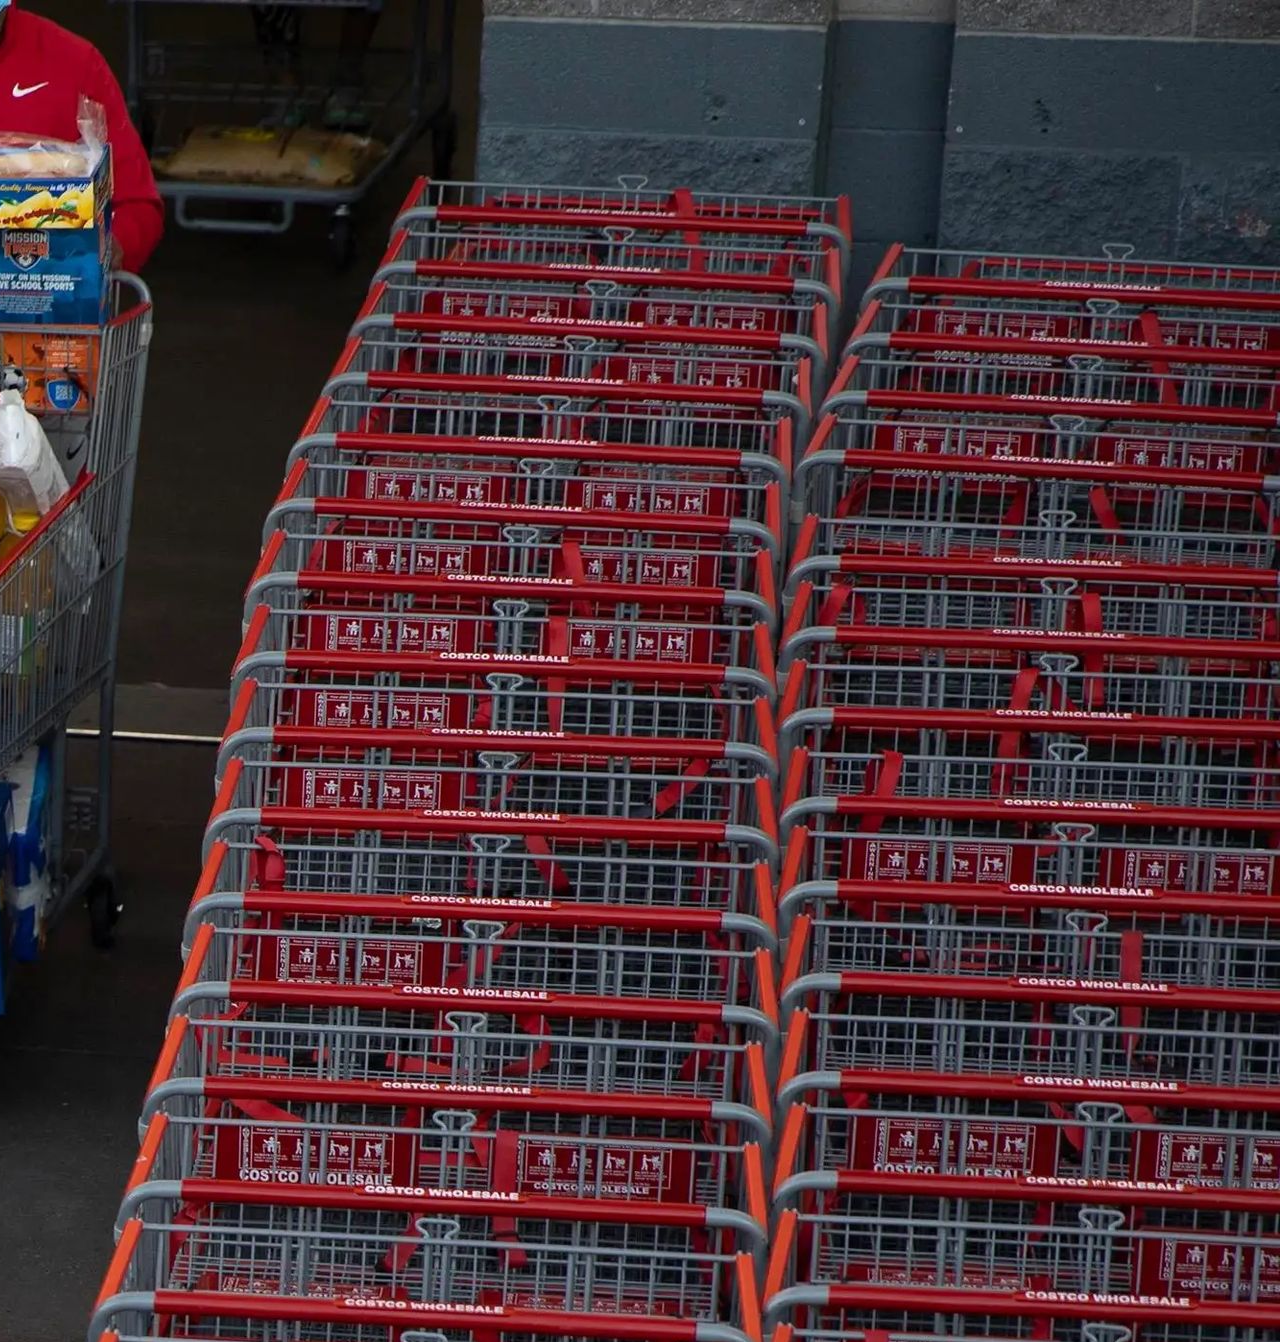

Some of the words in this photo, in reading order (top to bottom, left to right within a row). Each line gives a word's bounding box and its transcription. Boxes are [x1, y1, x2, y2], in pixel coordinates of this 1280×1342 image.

[4, 232, 48, 243] MISSION
[42, 274, 71, 282] MISSION
[11, 282, 42, 290] SCHOOL
[44, 282, 74, 290] SPORTS
[530, 314, 575, 324] COSTCO
[577, 316, 644, 328] WHOLESALE
[506, 374, 553, 382] COSTCO
[554, 374, 623, 385] WHOLESALE
[1010, 394, 1058, 402] COSTCO
[1060, 396, 1131, 405] WHOLESALE
[478, 433, 525, 442] COSTCO
[527, 434, 598, 446] WHOLESALE
[991, 455, 1040, 463] COSTCO
[1042, 457, 1115, 467] WHOLESALE
[460, 497, 508, 509] COSTCO
[510, 501, 582, 513] WHOLESALE
[993, 556, 1044, 564] COSTCO
[1046, 558, 1122, 567] WHOLESALE
[447, 571, 497, 582] COSTCO
[499, 574, 573, 585] WHOLESALE
[992, 628, 1045, 636] COSTCO
[1047, 630, 1125, 639] WHOLESALE
[439, 649, 491, 660] COSTCO
[492, 649, 569, 663] WHOLESALE
[995, 709, 1049, 717] COSTCO
[1051, 710, 1132, 719] WHOLESALE
[431, 726, 484, 735] COSTCO
[486, 726, 565, 738] WHOLESALE
[423, 807, 477, 817] COSTCO
[479, 808, 561, 821] WHOLESALE
[1009, 883, 1066, 894] COSTCO
[411, 893, 467, 904] COSTCO
[469, 894, 552, 908] WHOLESALE
[402, 983, 460, 996] COSTCO
[462, 983, 548, 1000] WHOLESALE
[1018, 977, 1077, 987] COSTCO
[1080, 980, 1168, 992] WHOLESALE
[1023, 1075, 1084, 1086] COSTCO
[1087, 1078, 1178, 1091] WHOLESALE
[240, 1168, 298, 1184] COSTCO
[364, 1183, 426, 1196] COSTCO
[428, 1188, 519, 1201] WHOLESALE
[344, 1296, 407, 1309] COSTCO
[410, 1301, 504, 1314] WHOLESALE
[1025, 1290, 1089, 1302] COSTCO
[1092, 1293, 1190, 1307] WHOLESALE
